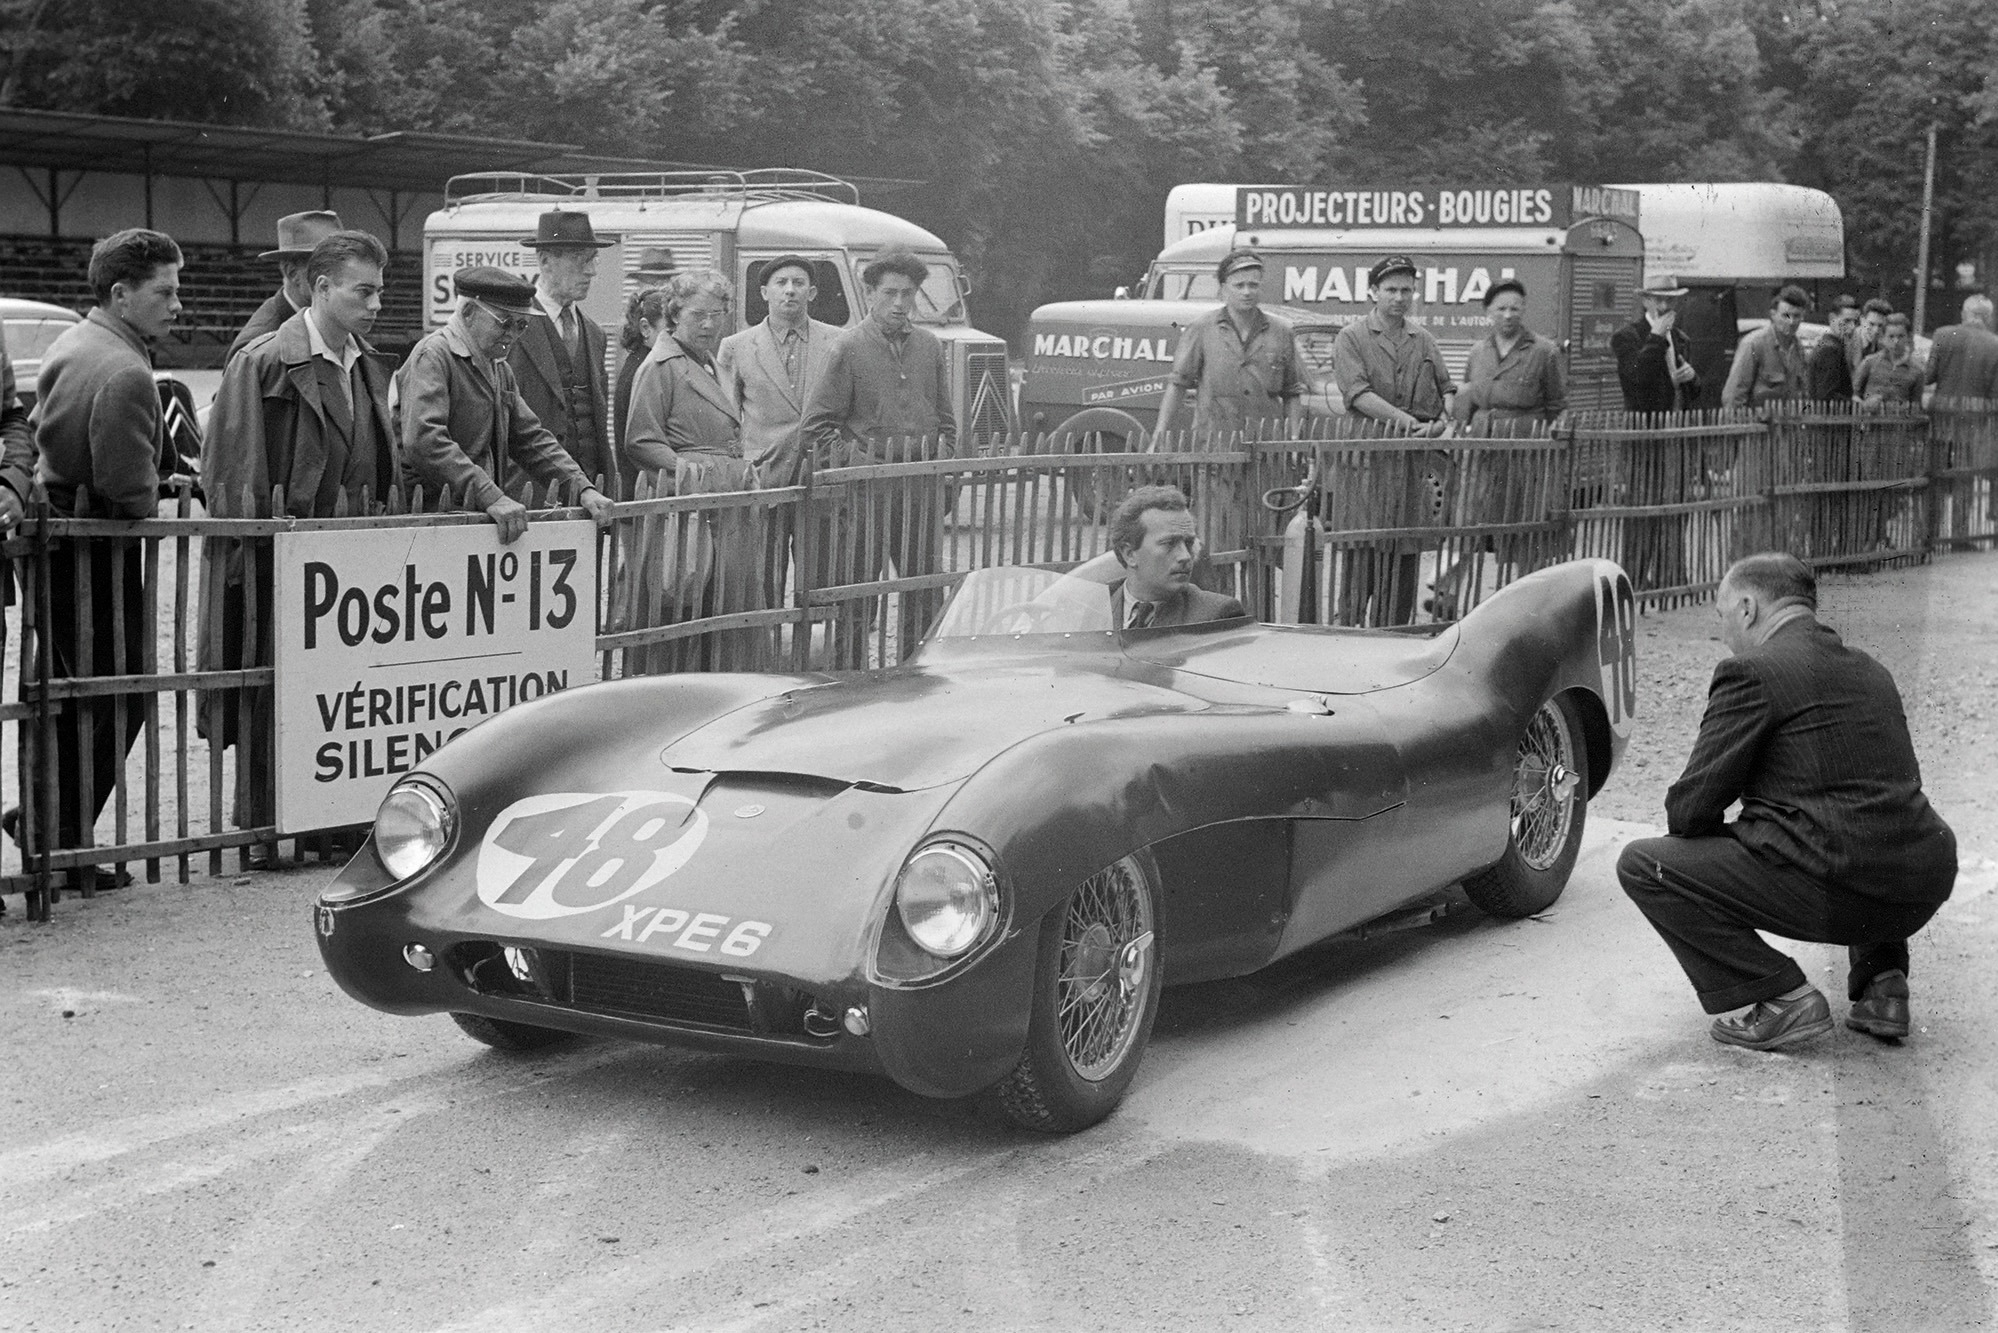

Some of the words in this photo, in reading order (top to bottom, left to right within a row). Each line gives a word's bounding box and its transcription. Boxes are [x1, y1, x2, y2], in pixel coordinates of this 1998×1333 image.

[1246, 191, 1424, 224] PROJECTEURS
[1439, 189, 1553, 223] BOUGIES
[455, 252, 520, 267] SERVICE
[1034, 333, 1174, 362] MARCHAL
[1091, 390, 1114, 401] PAR
[1121, 382, 1164, 396] AVION
[303, 561, 451, 650] Poste
[315, 669, 568, 732] VÉRIFICATION
[493, 795, 698, 908] 48
[600, 904, 773, 957] XPE6
